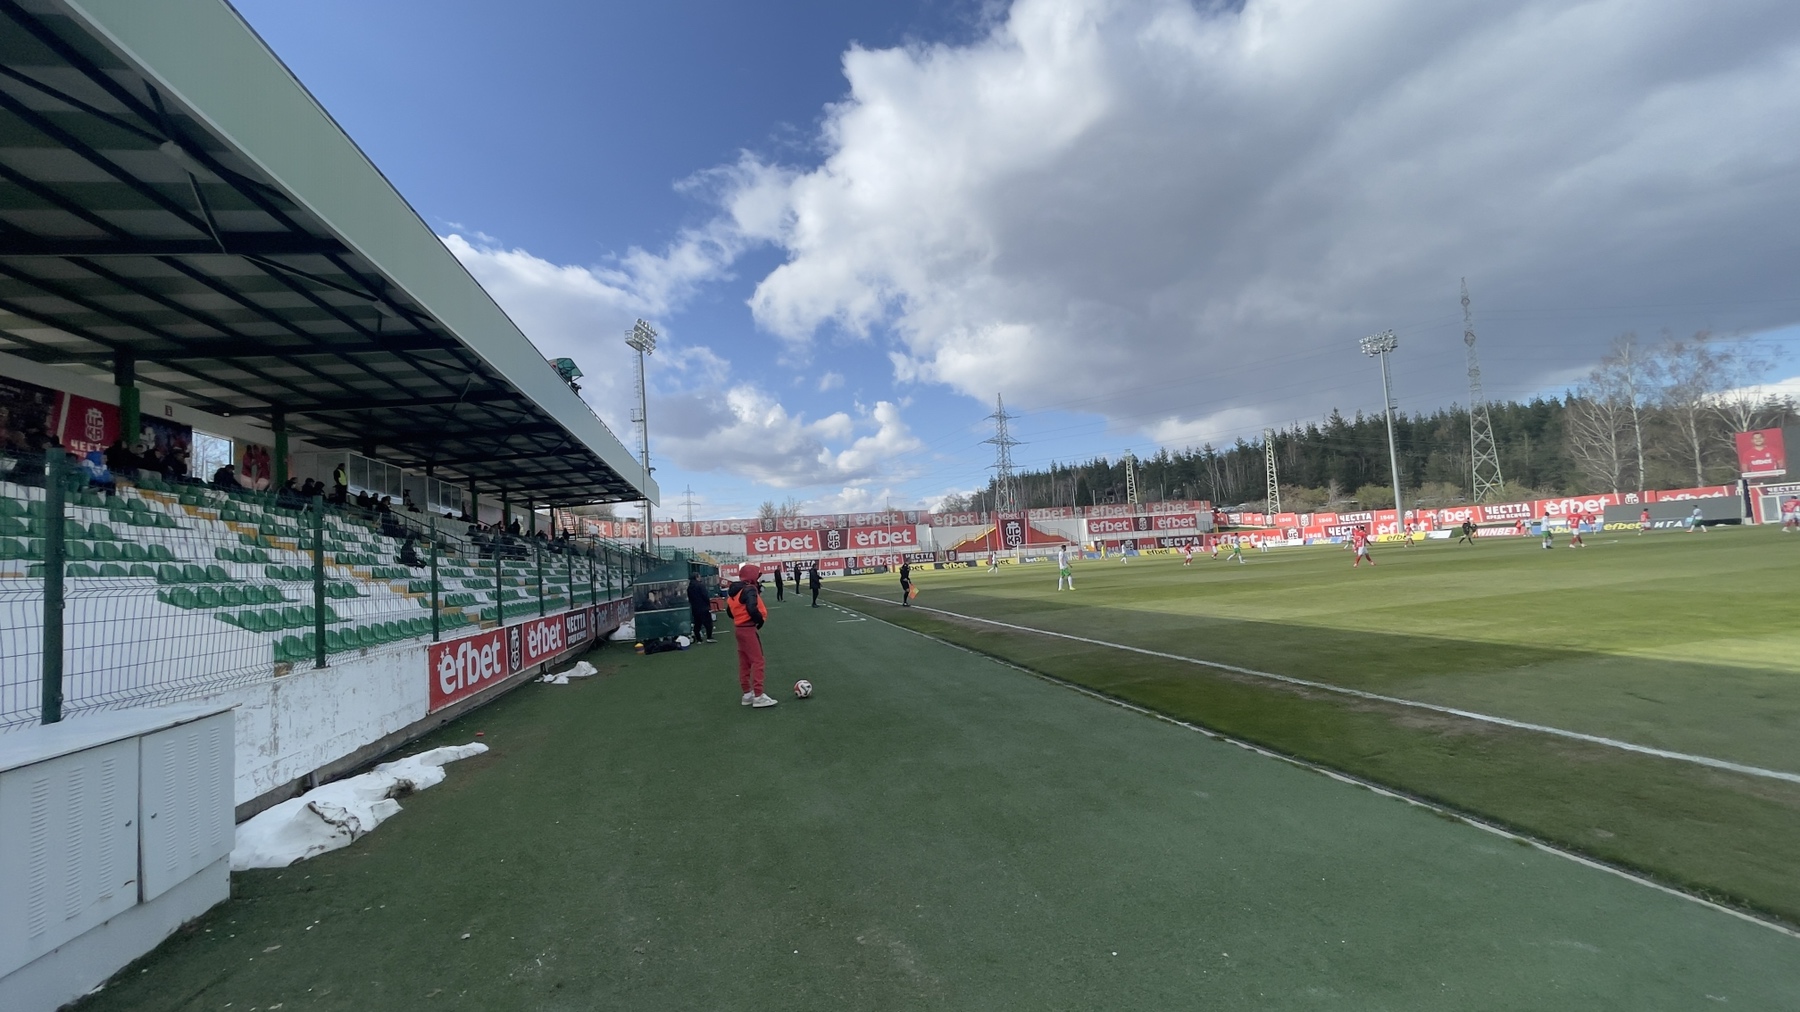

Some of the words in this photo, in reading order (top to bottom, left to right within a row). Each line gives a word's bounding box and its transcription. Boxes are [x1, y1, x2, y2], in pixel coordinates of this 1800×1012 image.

[71, 439, 109, 452] ЧЕСТ
[1090, 504, 1129, 516] efbet
[1484, 503, 1530, 515] ЧЕСТТА
[1544, 496, 1610, 515] efbet
[783, 516, 827, 530] efbet
[855, 512, 898, 526] efbet
[933, 513, 974, 526] efbet
[1156, 516, 1195, 528] efbet
[1339, 512, 1373, 521] ЧЕСТТА
[1089, 520, 1130, 532] efbet
[1478, 527, 1518, 536] WINBET
[753, 534, 814, 552] efbet
[855, 530, 911, 546] efbet
[862, 554, 899, 566] efbet
[567, 612, 587, 633] ЧЕСТТА
[528, 618, 562, 658] efbet
[438, 634, 501, 694] efbet
